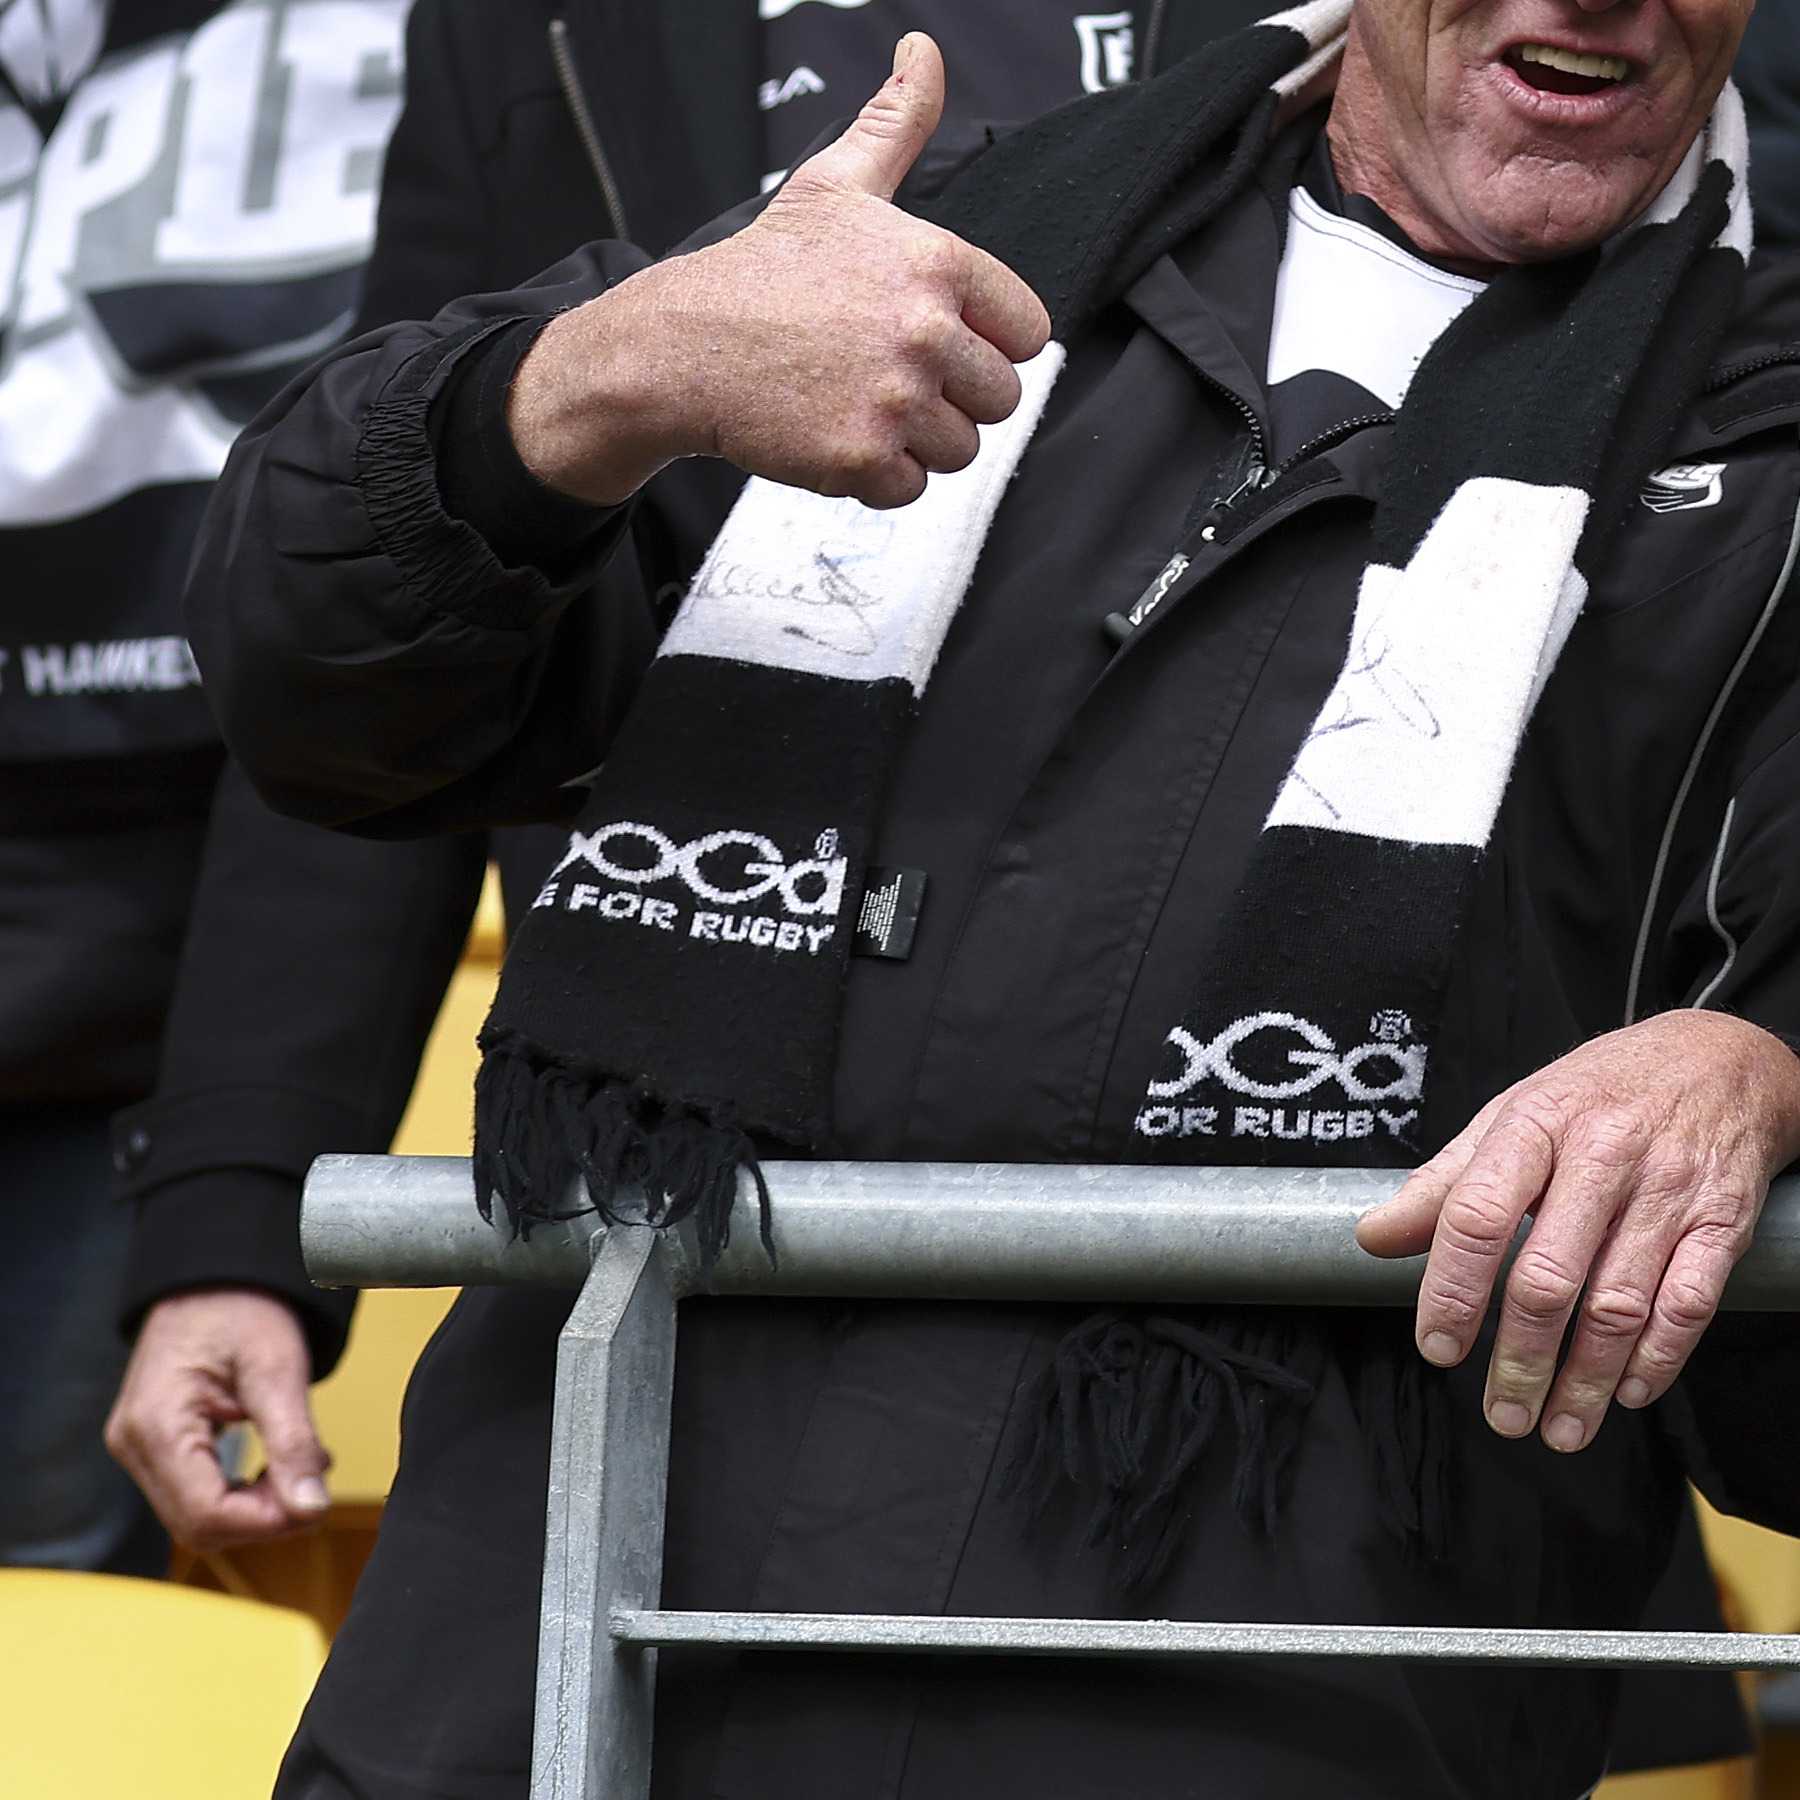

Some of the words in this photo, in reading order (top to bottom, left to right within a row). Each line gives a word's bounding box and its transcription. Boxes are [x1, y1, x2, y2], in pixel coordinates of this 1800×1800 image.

[568, 882, 680, 931] FOR
[688, 911, 836, 956] RUGBY
[1230, 1105, 1420, 1142] RUGBY
